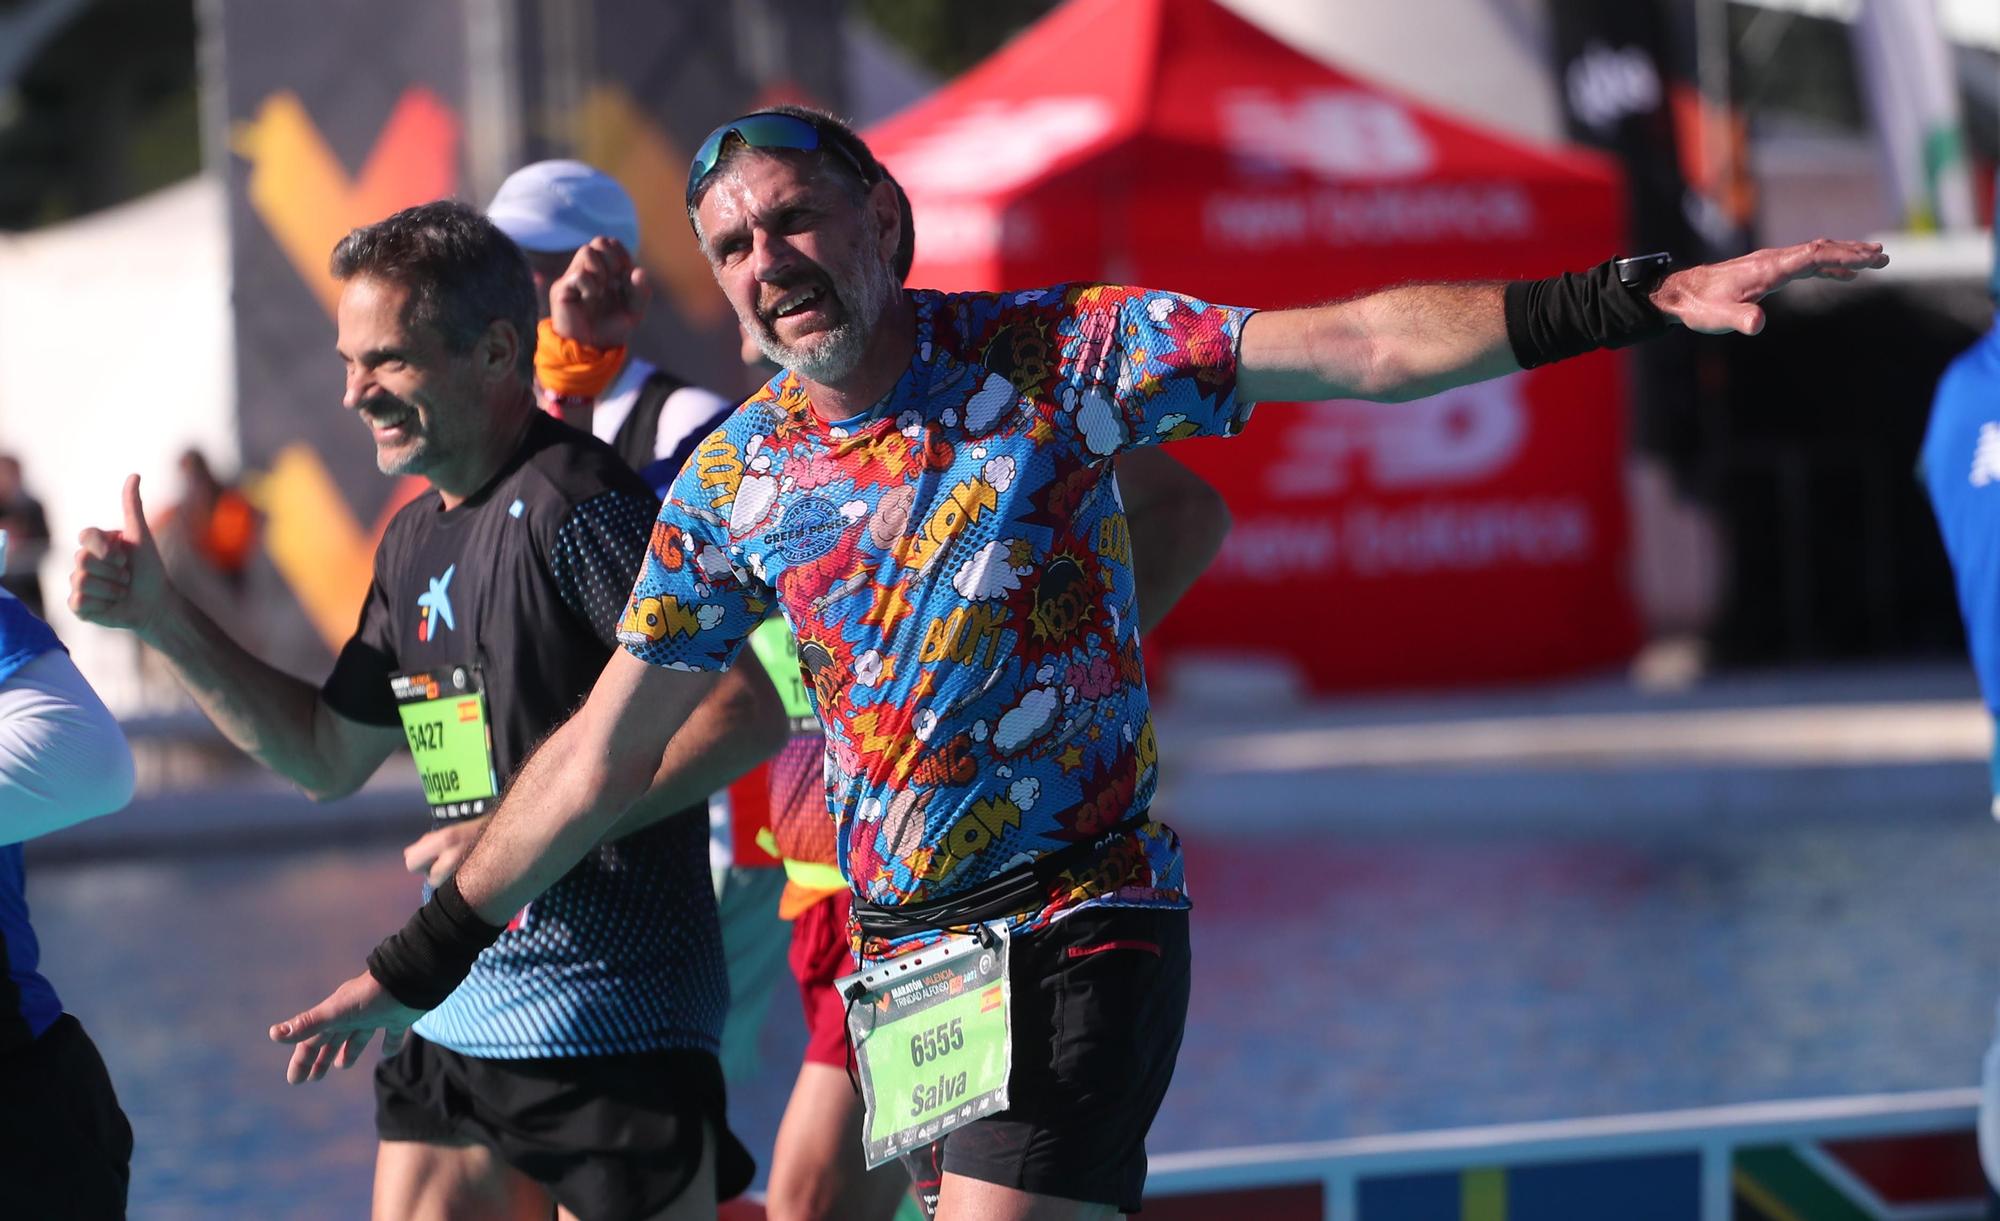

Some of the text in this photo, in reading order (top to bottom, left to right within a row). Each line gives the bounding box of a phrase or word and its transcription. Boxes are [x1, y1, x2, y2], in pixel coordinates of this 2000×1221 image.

[764, 515, 850, 545] GREEN POWER
[918, 603, 1009, 670] BOOM
[895, 991, 922, 1009] TRINIDAD
[922, 981, 949, 999] ALFONSO
[923, 968, 955, 987] VALENCIA
[910, 1017, 964, 1068] 6555
[911, 1070, 967, 1117] Salva
